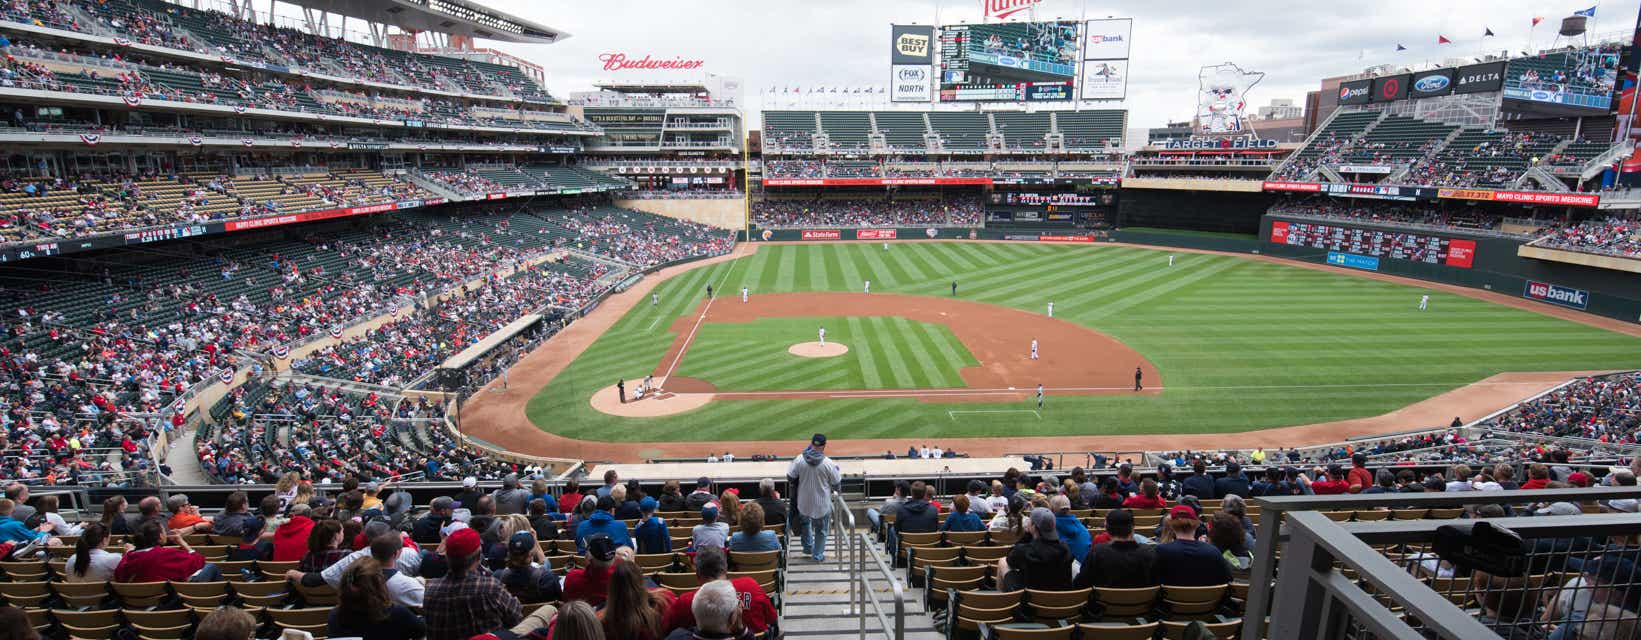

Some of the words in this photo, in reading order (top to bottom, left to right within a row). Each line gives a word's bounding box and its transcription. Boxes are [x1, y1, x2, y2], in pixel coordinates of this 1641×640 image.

[901, 37, 928, 46] BEST
[901, 45, 925, 53] BUY
[599, 53, 704, 71] Budweiser
[904, 69, 919, 77] FOX
[1468, 73, 1500, 83] DELTA
[898, 84, 924, 93] NORTH
[1421, 79, 1443, 90] Ford
[1349, 86, 1369, 99] pepsi
[1166, 139, 1219, 149] TARGET
[1233, 139, 1278, 149] FIELD
[1561, 195, 1594, 204] MEDICINE
